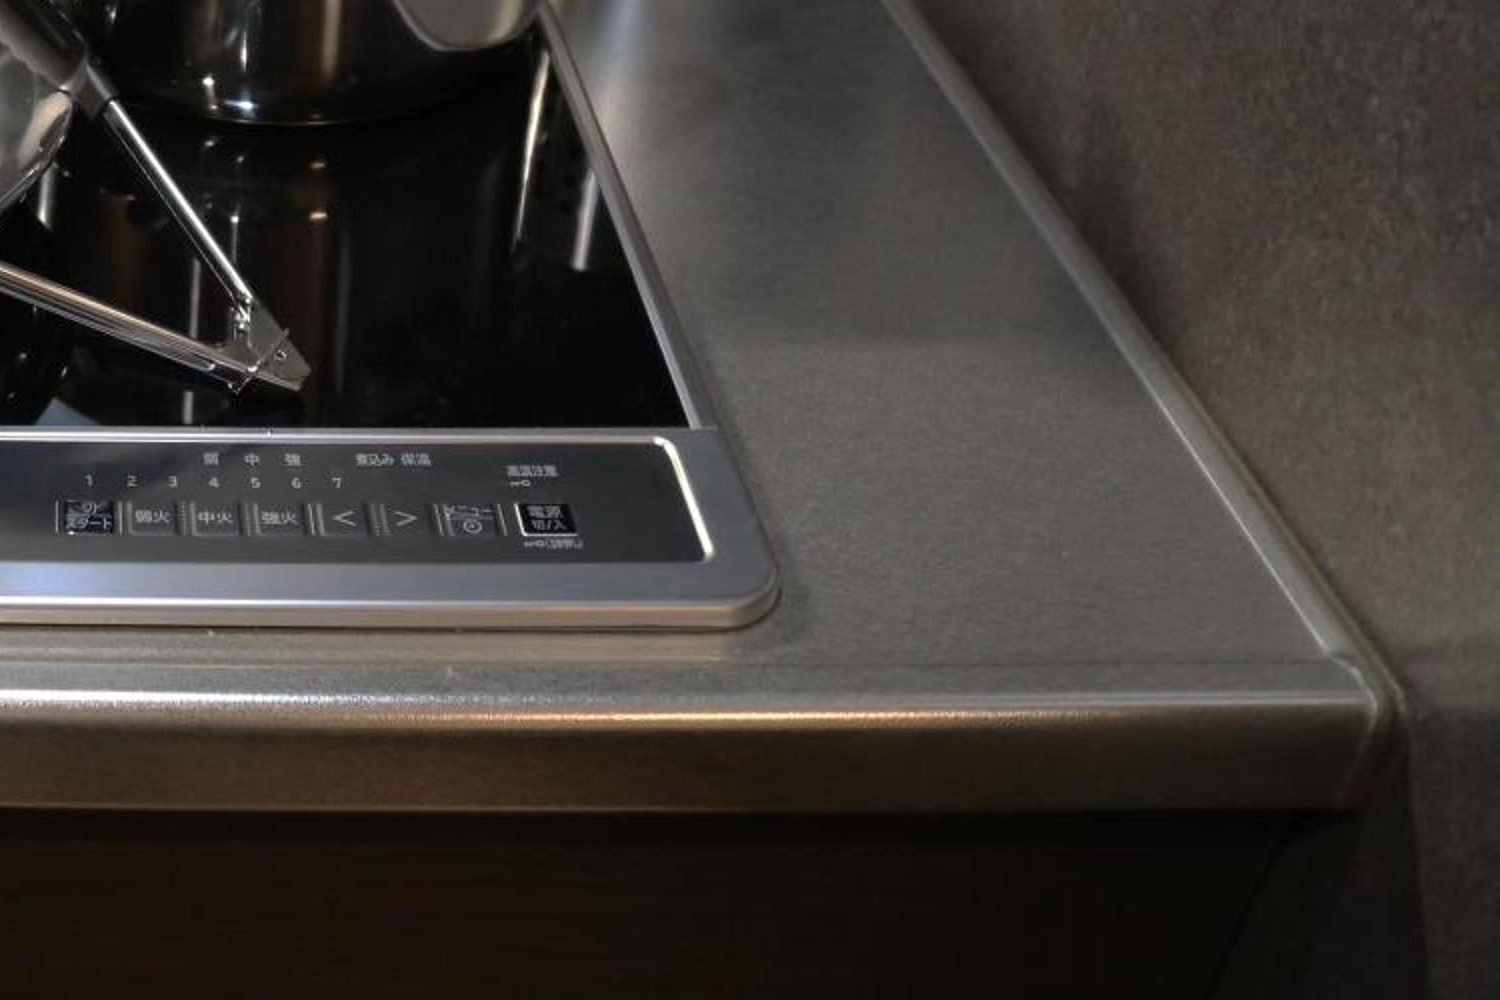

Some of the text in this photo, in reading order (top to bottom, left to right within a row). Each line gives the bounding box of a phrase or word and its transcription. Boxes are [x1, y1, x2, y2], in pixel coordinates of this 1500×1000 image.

[245, 453, 260, 466] 中
[84, 475, 341, 489] 1 2 3 4 5 6 7
[198, 511, 233, 523] 中火
